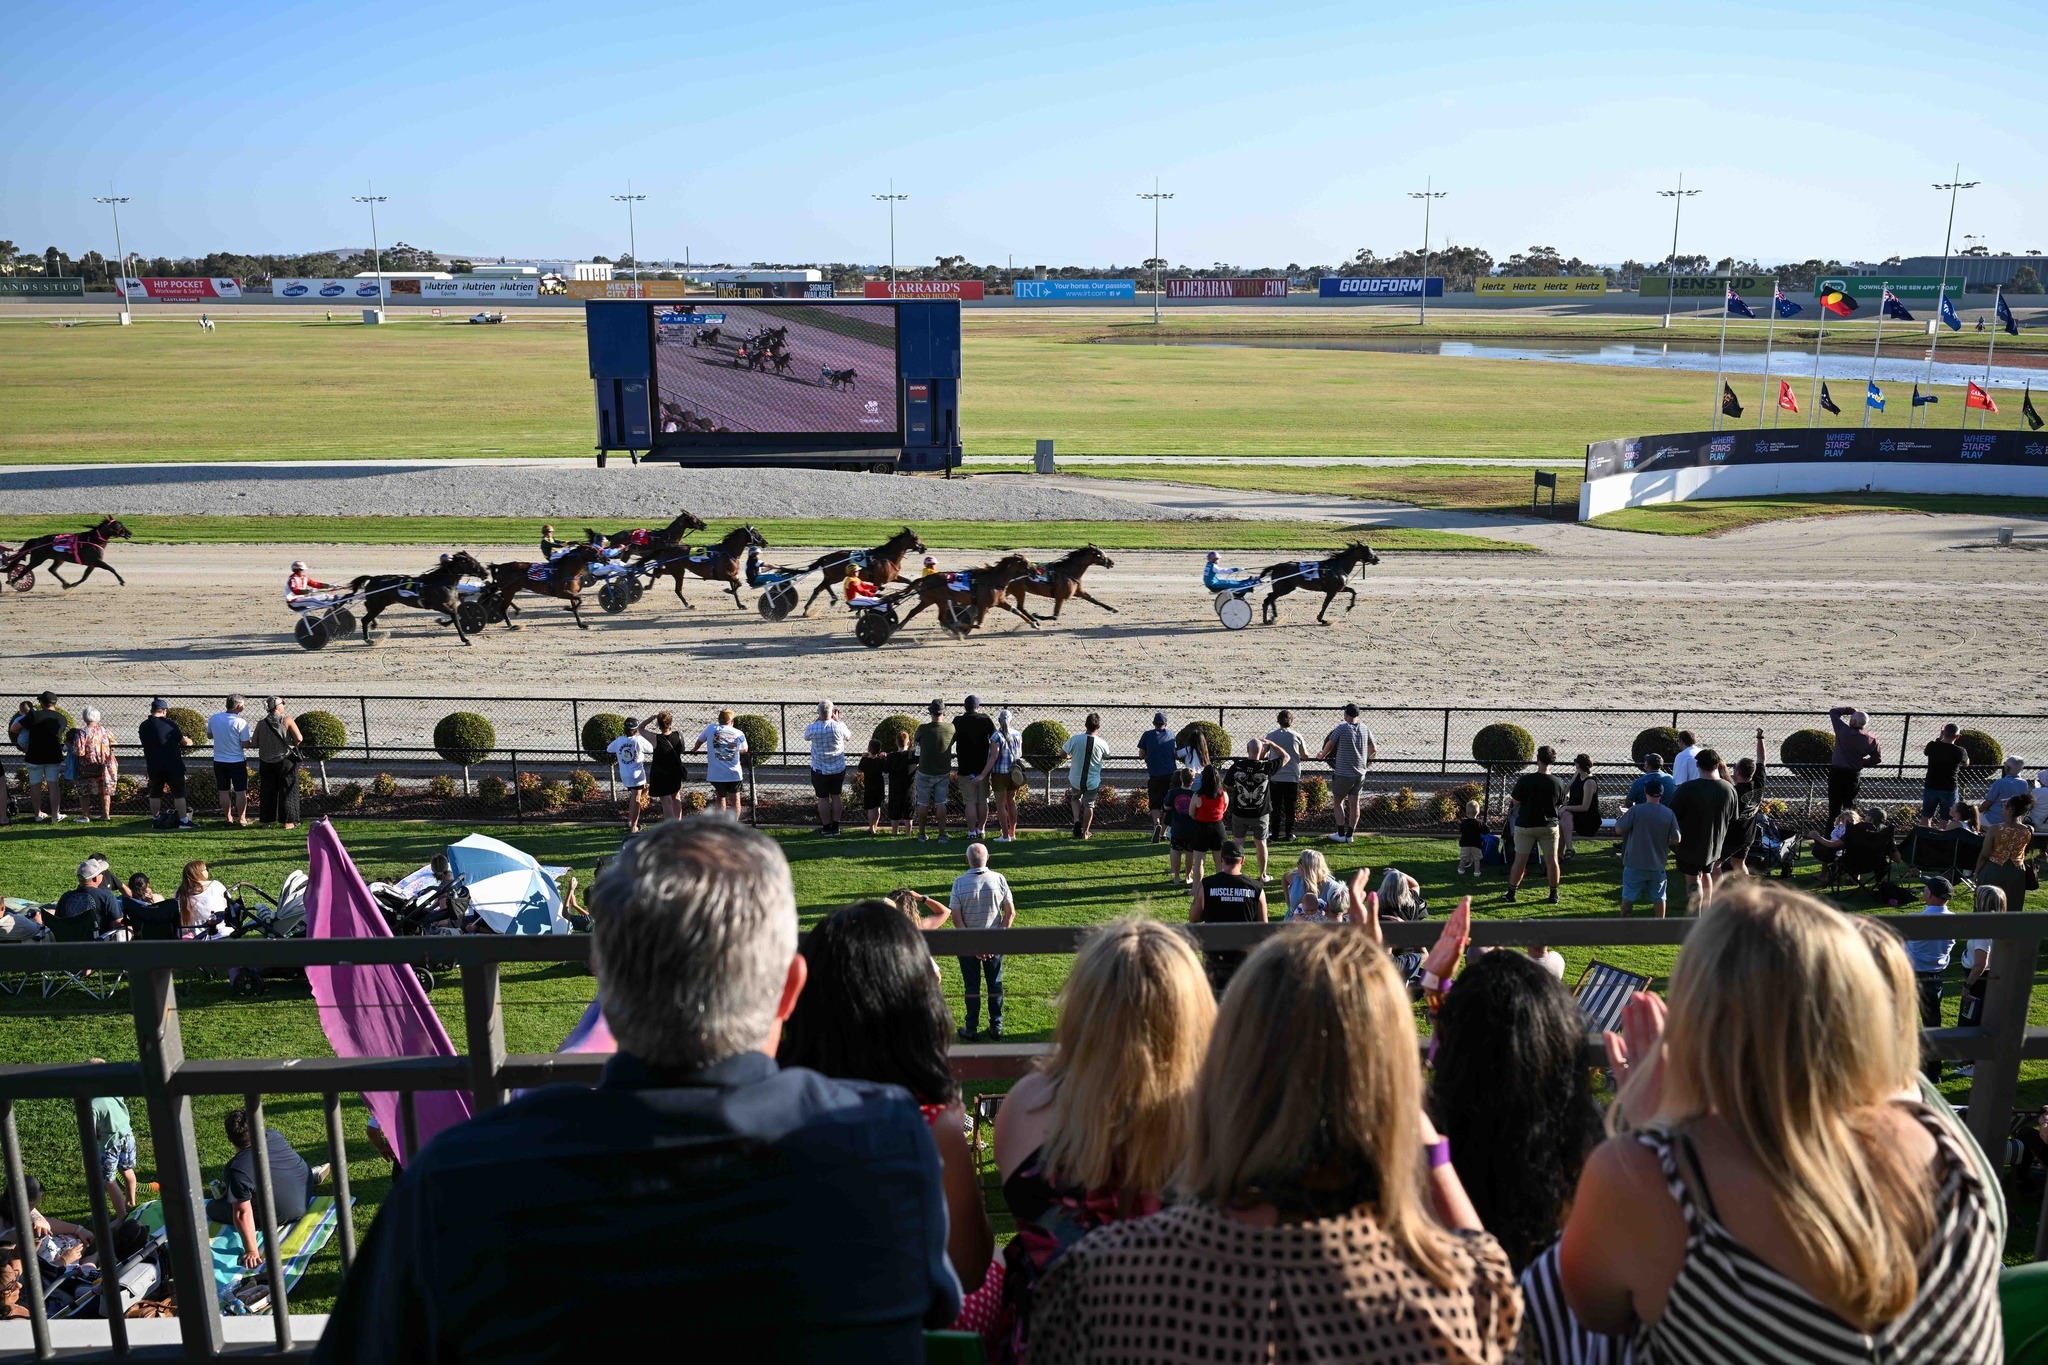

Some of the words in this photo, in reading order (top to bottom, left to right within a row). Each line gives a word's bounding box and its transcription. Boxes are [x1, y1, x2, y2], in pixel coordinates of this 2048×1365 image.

[154, 281, 168, 289] HIP
[171, 281, 203, 289] POCKET
[425, 282, 458, 290] Nutrien
[462, 282, 496, 290] Nutrien
[500, 282, 534, 290] Nutrien
[888, 282, 960, 292] GARRARD'S
[1339, 280, 1423, 292] GOODFORM
[1668, 278, 1756, 289] BENSTUD
[1016, 282, 1044, 297] IRT
[1170, 281, 1285, 296] ALDEBARANPARK.COM
[718, 288, 742, 298] UNSEE
[744, 288, 763, 298] THIS!
[1712, 436, 1735, 444] WHERE
[1826, 433, 1856, 441] WHERE
[1963, 435, 1997, 443] WHERE
[1625, 443, 1642, 452] WHERE
[1710, 444, 1731, 452] STARS
[1825, 441, 1850, 449] STARS
[1962, 443, 1990, 451] STARS
[1624, 451, 1639, 460] STARS
[1709, 452, 1726, 461] PLAY
[1961, 451, 1983, 459] PLAY
[1623, 460, 1635, 469] PLAY
[1210, 887, 1233, 896] MUSCLE
[1234, 888, 1255, 898] NATION
